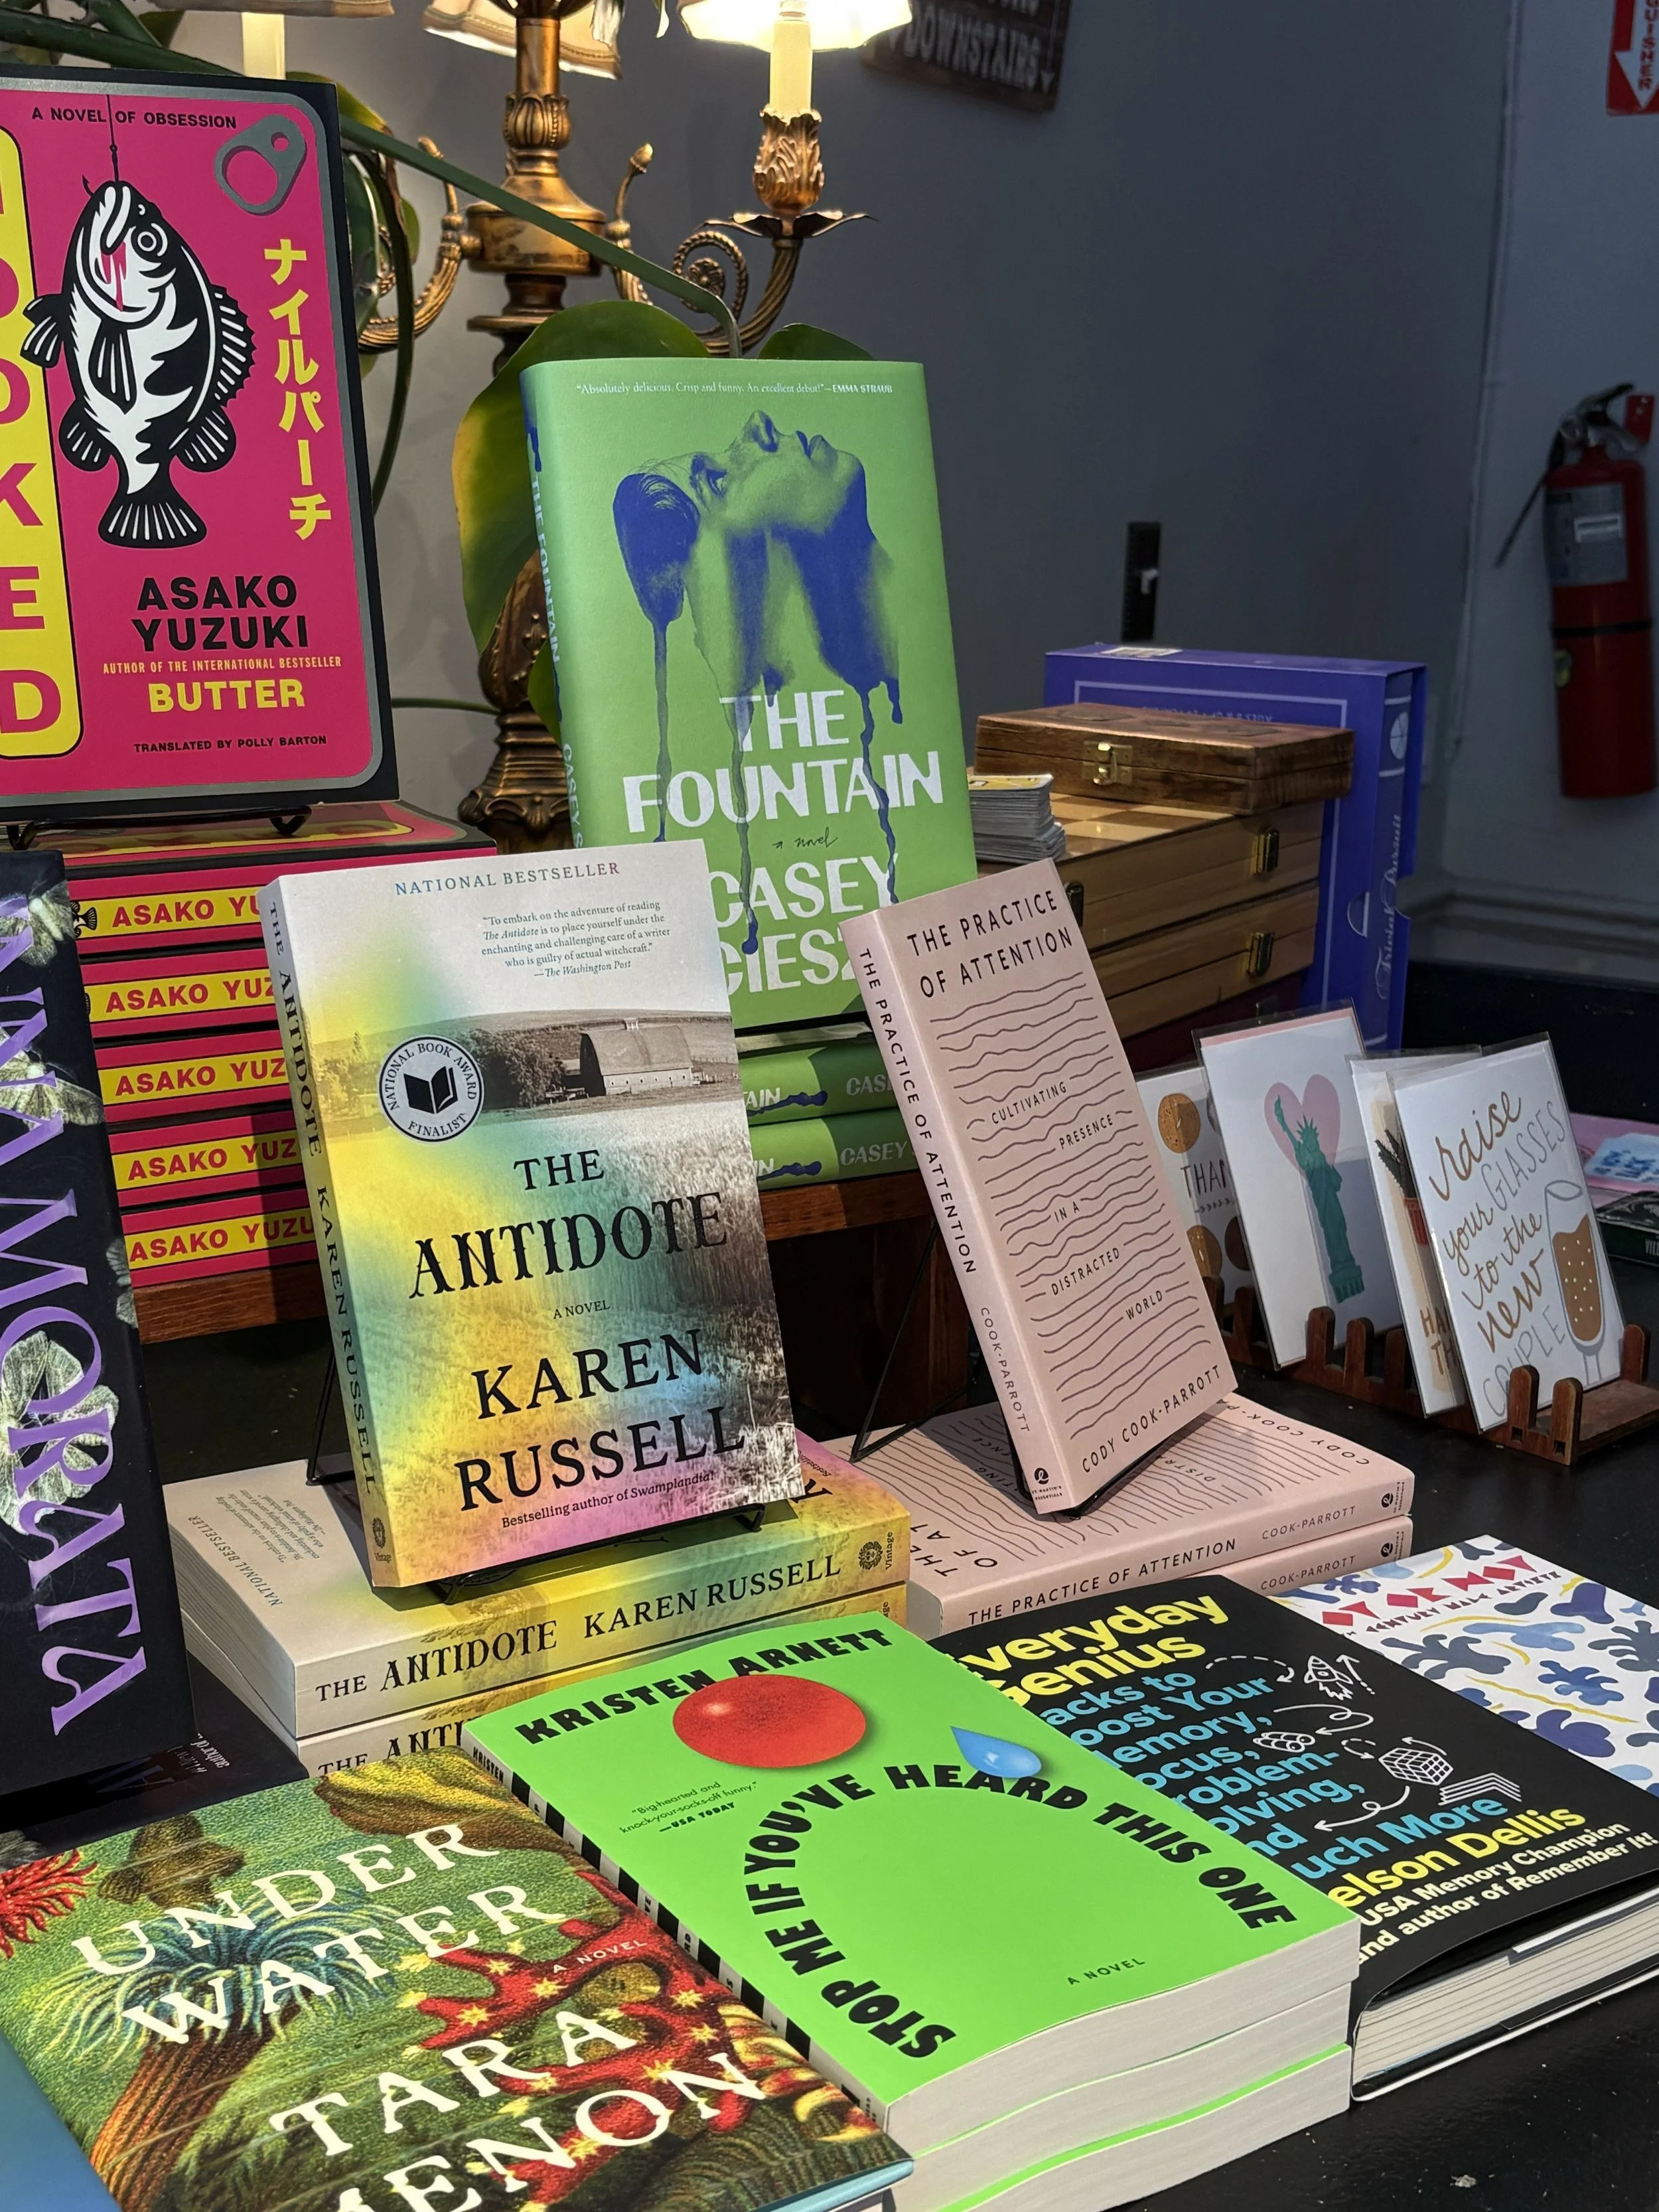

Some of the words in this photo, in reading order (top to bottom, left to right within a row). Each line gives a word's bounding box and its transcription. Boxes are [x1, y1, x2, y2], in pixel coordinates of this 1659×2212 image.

[32, 107, 43, 120] A
[51, 108, 106, 123] NOVEL
[115, 111, 137, 124] OF
[143, 112, 237, 129] OBSESSION
[264, 238, 332, 540] ナイルパーチ
[761, 382, 794, 394] excellent
[860, 384, 893, 394] STRAUB
[137, 575, 297, 611] ASAKO
[131, 615, 309, 652] YUZUKI
[103, 661, 145, 675] AUTHOR
[150, 660, 163, 672] OF
[168, 660, 188, 672] THE
[192, 657, 275, 672] INTERNATIONAL
[279, 656, 342, 670] BESTSELLER
[148, 678, 305, 713] BUTTER
[133, 739, 212, 753] TRANSLATED
[217, 738, 232, 749] BY
[237, 737, 274, 748] POLLY
[279, 735, 326, 747] BARTON
[719, 690, 849, 752] THE
[622, 750, 943, 834] FOUNTAIN
[794, 827, 838, 849] novel
[395, 873, 497, 897] NATIONAL
[502, 861, 620, 885] BESTSELLER
[709, 853, 899, 928] CASEY
[111, 898, 215, 928] ASAKO
[483, 929, 500, 940] The
[501, 924, 539, 939] Antidote
[540, 925, 547, 934] is
[549, 924, 559, 933] to
[561, 920, 585, 936] place
[587, 916, 622, 934] yourself
[623, 915, 648, 926] under
[650, 913, 665, 923] the
[503, 911, 538, 925] embark
[553, 908, 569, 919] the
[571, 905, 614, 917] adventure
[616, 902, 626, 913] of
[627, 899, 661, 915] reading
[906, 923, 952, 957] THE
[960, 889, 1058, 941] PRACTICE
[481, 939, 534, 956] enchanting
[534, 938, 552, 950] and
[553, 932, 606, 950] challenging
[607, 932, 625, 942] care
[626, 928, 636, 939] of
[644, 926, 671, 938] writer
[505, 957, 526, 968] who
[526, 955, 535, 965] is
[536, 952, 563, 968] guilty
[564, 950, 574, 961] of
[573, 946, 603, 960] actual
[920, 969, 948, 999] OF
[960, 926, 1074, 986] ATTENTION
[561, 960, 613, 977] Washington
[614, 959, 632, 971] Post
[105, 984, 209, 1013] ASAKO
[115, 1065, 216, 1097] ASAKO
[387, 1045, 416, 1112] NATIONAL
[417, 1041, 453, 1059] BOOK
[453, 1054, 478, 1102] AWARD
[406, 1112, 469, 1138] FINALIST
[991, 1080, 1068, 1125] CULTIVATING
[839, 1140, 907, 1166] CASEY
[1059, 1114, 1114, 1149] PRESENCE
[1428, 1090, 1522, 1202] raise
[127, 1147, 228, 1181] ASAKO
[513, 1149, 605, 1191] THE
[1441, 1207, 1494, 1275] your
[1480, 1099, 1567, 1211] GLASSES
[268, 901, 286, 956] THE
[277, 969, 323, 1158] ANTIDOTE
[316, 1185, 348, 1317] KAREN
[340, 1327, 375, 1495] RUSSELL
[859, 948, 881, 990] THE
[875, 999, 920, 1105] PRACTICE
[914, 1114, 933, 1141] OF
[926, 1151, 977, 1274] ATTENTION
[980, 1307, 1030, 1434] COOK-PARROTT
[1053, 1207, 1068, 1223] IN
[1072, 1203, 1080, 1213] A
[129, 1228, 229, 1262] ASAKO
[408, 1190, 728, 1301] ANTIDOTE
[1051, 1246, 1121, 1297] DISTRACTED
[553, 1308, 563, 1319] A
[564, 1299, 611, 1317] NOVEL
[1125, 1290, 1164, 1321] WORLD
[470, 1327, 705, 1421] KAREN
[1482, 1304, 1566, 1418] COUPLE
[1082, 1436, 1116, 1473] CODY
[1121, 1364, 1222, 1443] COOK-PARROTT
[454, 1404, 746, 1512] RUSSELL
[501, 1500, 571, 1529] Bestselling
[571, 1492, 614, 1512] author
[613, 1487, 630, 1503] of
[630, 1470, 715, 1499] Swamplandia!
[236, 1561, 283, 1607] NATIONAL
[968, 1606, 1003, 1625] THE
[1011, 1576, 1100, 1613] PRACTICE
[1109, 1566, 1131, 1584] OF
[1137, 1537, 1237, 1578] ATTENTION
[1261, 1505, 1356, 1541] COOK-PARROTT
[1260, 1554, 1356, 1591] COOK-PARROTT
[315, 1672, 368, 1703] THE
[379, 1619, 557, 1693] ANTIDOTE
[583, 1587, 699, 1639] KAREN
[707, 1554, 841, 1606] RUSSELL
[945, 1595, 1229, 1680] veryday
[515, 1669, 716, 1745] KRISTEN
[729, 1628, 893, 1678] ARNETT
[1141, 1671, 1196, 1694] to
[1161, 1675, 1274, 1712] Your
[473, 1746, 504, 1784] KRISTEN
[884, 1764, 1088, 1810] HEARD
[619, 1792, 721, 1834] knock-your-socks-off
[721, 1781, 757, 1799] funny.”
[631, 1789, 697, 1816] “Big-hearted
[700, 1781, 721, 1793] and
[697, 1802, 735, 1820] TODAY
[1376, 1797, 1508, 1845] More
[744, 1773, 876, 1876] YOU’VE
[1092, 1802, 1212, 1864] THIS
[1445, 1805, 1587, 1859] Dellis
[1359, 1896, 1417, 1928] USA
[1419, 1861, 1511, 1902] Memory
[1511, 1821, 1631, 1867] Champion
[1397, 1897, 1483, 1937] author
[1484, 1883, 1509, 1901] of
[1507, 1843, 1629, 1891] Remember
[1630, 1832, 1659, 1854] It!
[70, 1823, 500, 1976] UNDER
[745, 1882, 806, 1915] IF
[1198, 1866, 1298, 1931] ONE
[121, 1884, 566, 2045] WATER
[553, 1962, 566, 1974] A
[575, 1938, 648, 1966] NOVEL
[764, 1918, 846, 1976] ME
[1066, 1975, 1080, 1986] A
[1083, 1956, 1146, 1981] NOVEL
[821, 1980, 957, 2058] STOP
[268, 2010, 639, 2157] TARA
